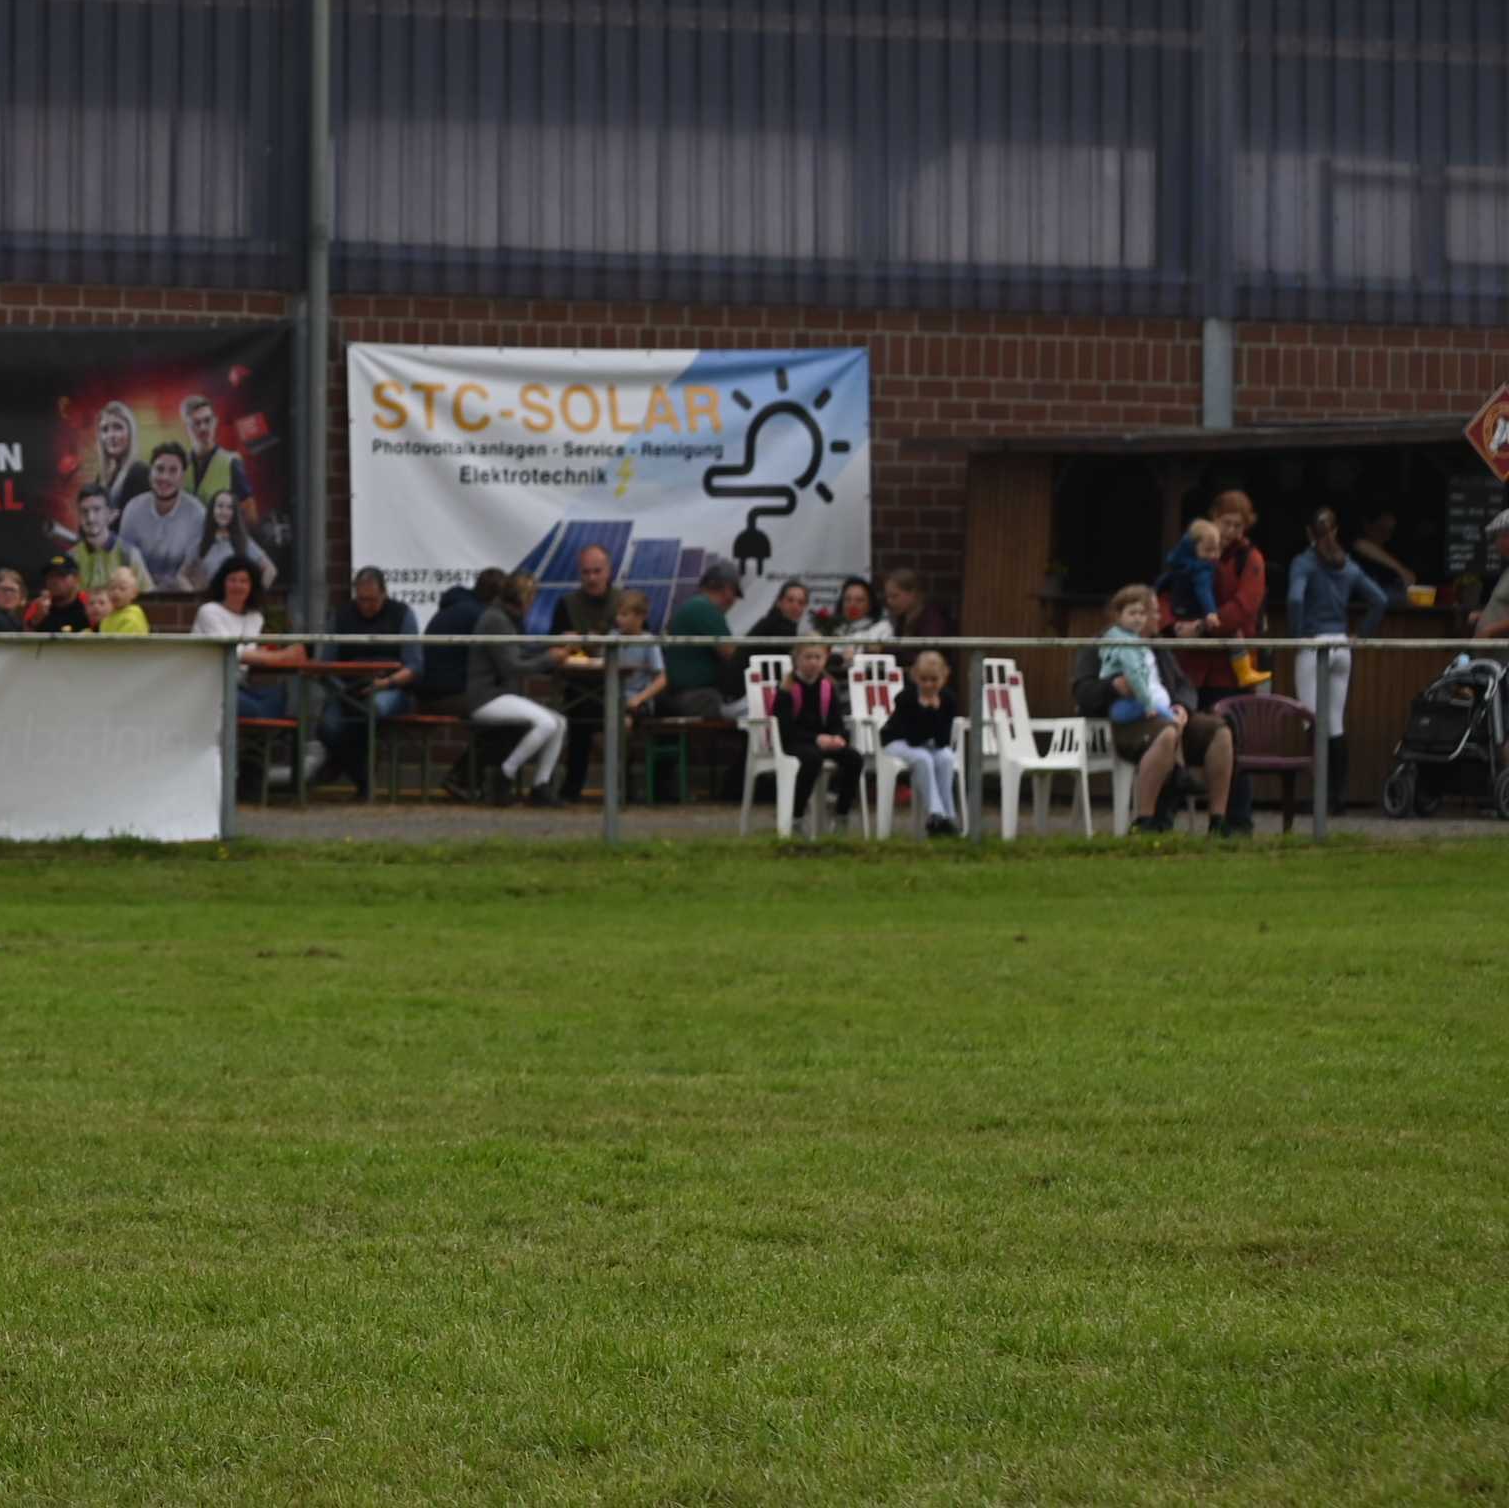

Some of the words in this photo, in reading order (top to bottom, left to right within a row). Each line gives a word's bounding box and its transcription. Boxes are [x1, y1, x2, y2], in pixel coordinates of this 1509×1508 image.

[372, 380, 723, 434] STC-SOLAR
[372, 439, 548, 459] Photovoltaikanlagen
[564, 442, 626, 458] Service
[641, 443, 724, 461] Reinigung
[459, 466, 609, 485] Elektrotechnik
